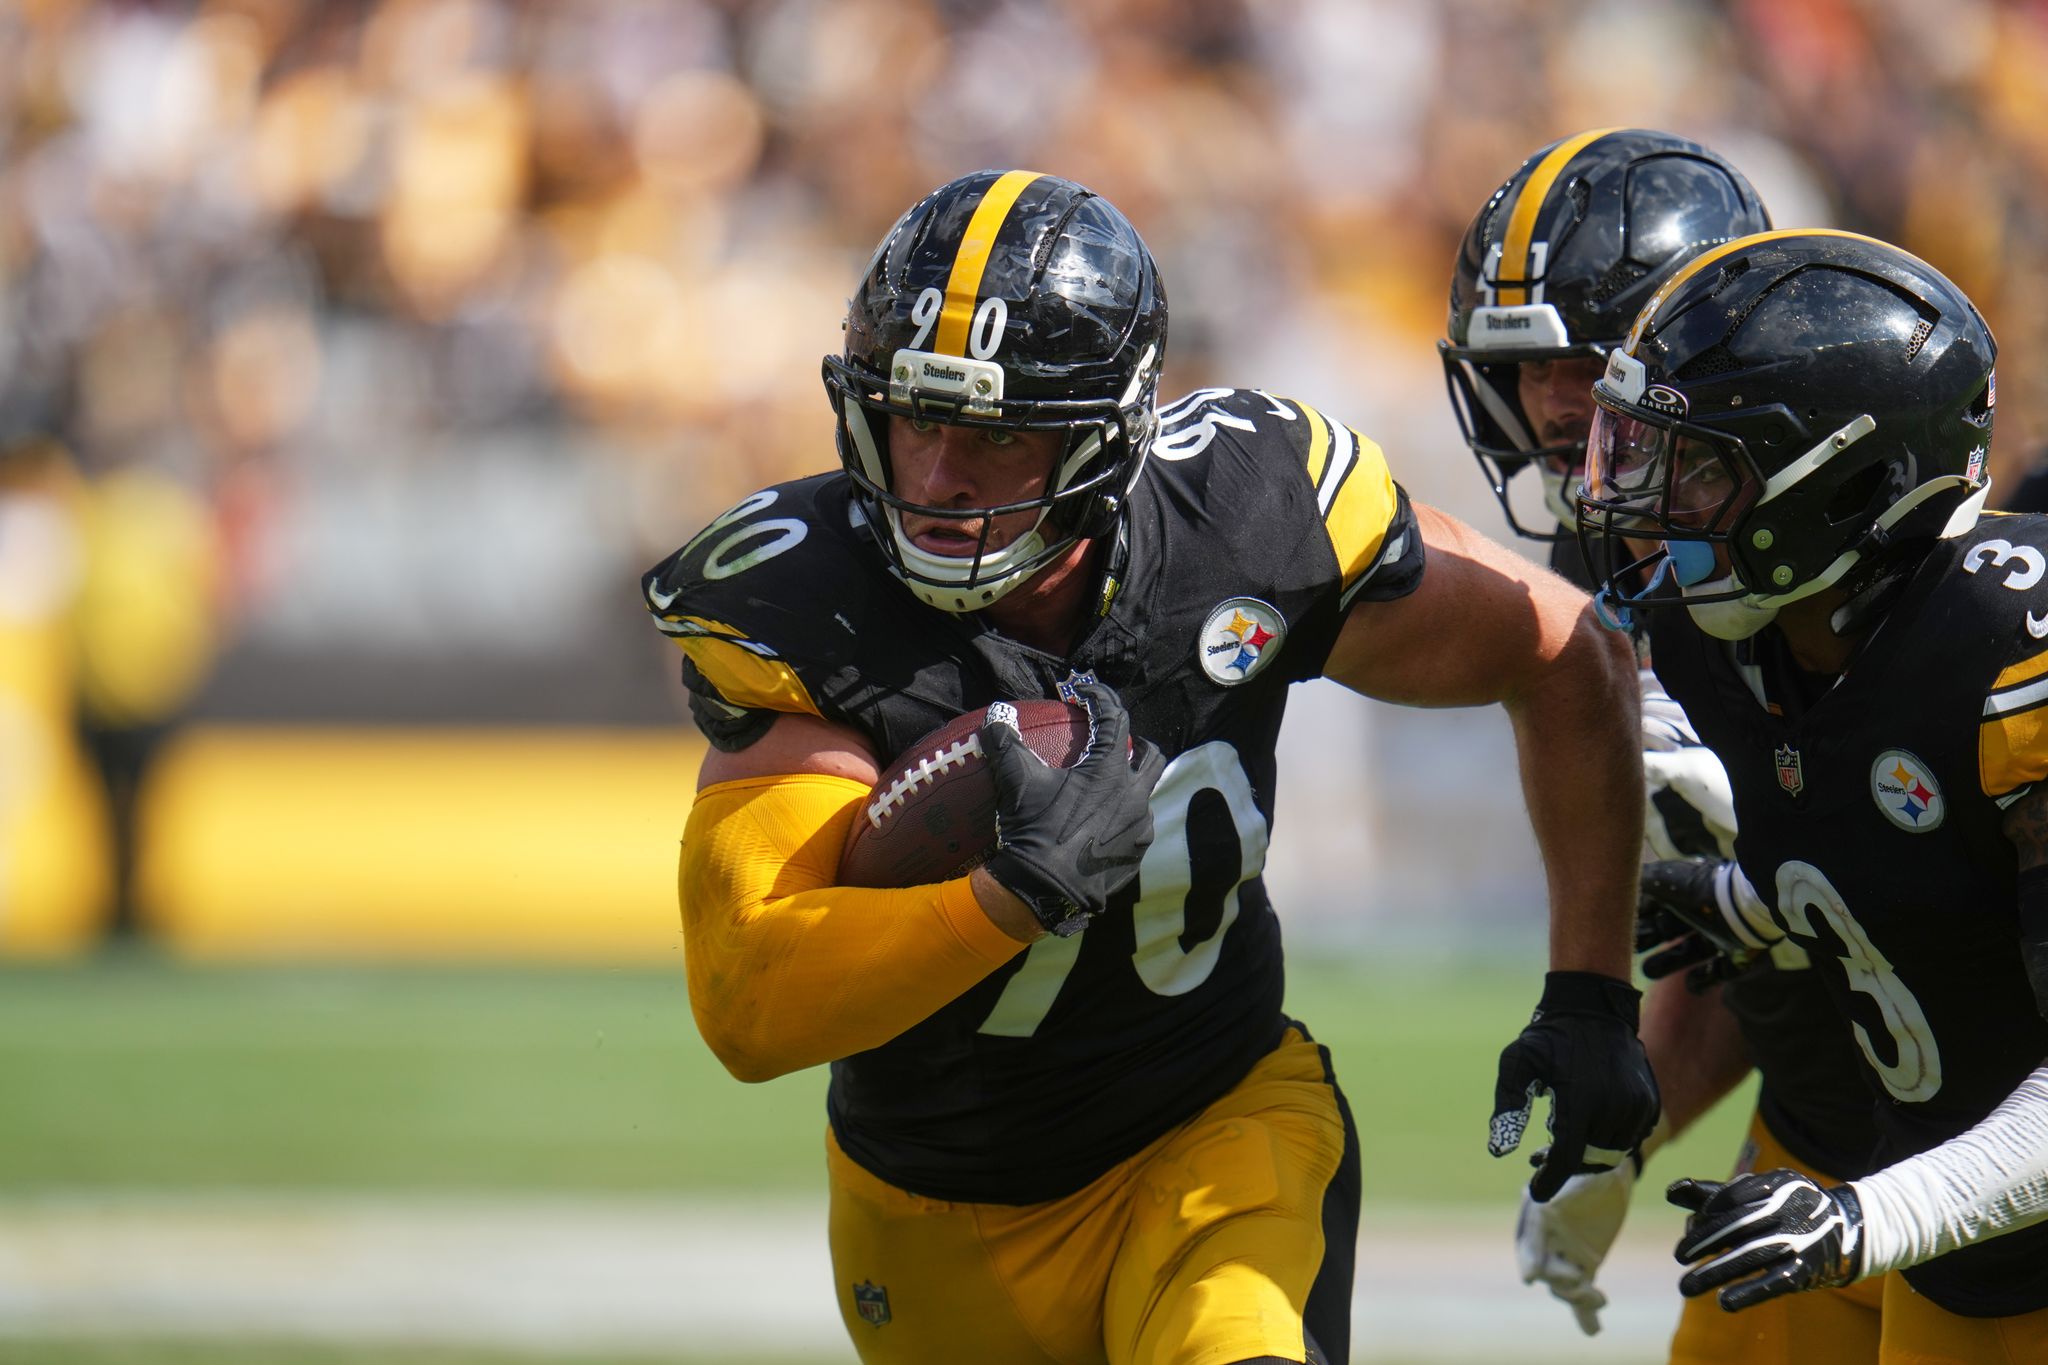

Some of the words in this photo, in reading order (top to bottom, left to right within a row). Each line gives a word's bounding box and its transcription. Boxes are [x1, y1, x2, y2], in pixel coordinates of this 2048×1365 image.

[1475, 241, 1549, 306] 41
[909, 287, 1008, 361] 90
[1486, 313, 1531, 330] Steelers
[923, 362, 966, 382] Steelers
[1151, 387, 1257, 461] 90
[1641, 398, 1685, 415] OAKLEY
[680, 490, 808, 580] 90
[1963, 539, 2046, 591] 3
[1207, 640, 1240, 656] Steelers
[1780, 768, 1799, 787] NFL
[1877, 782, 1906, 795] Steelers
[1775, 860, 1942, 1103] 3
